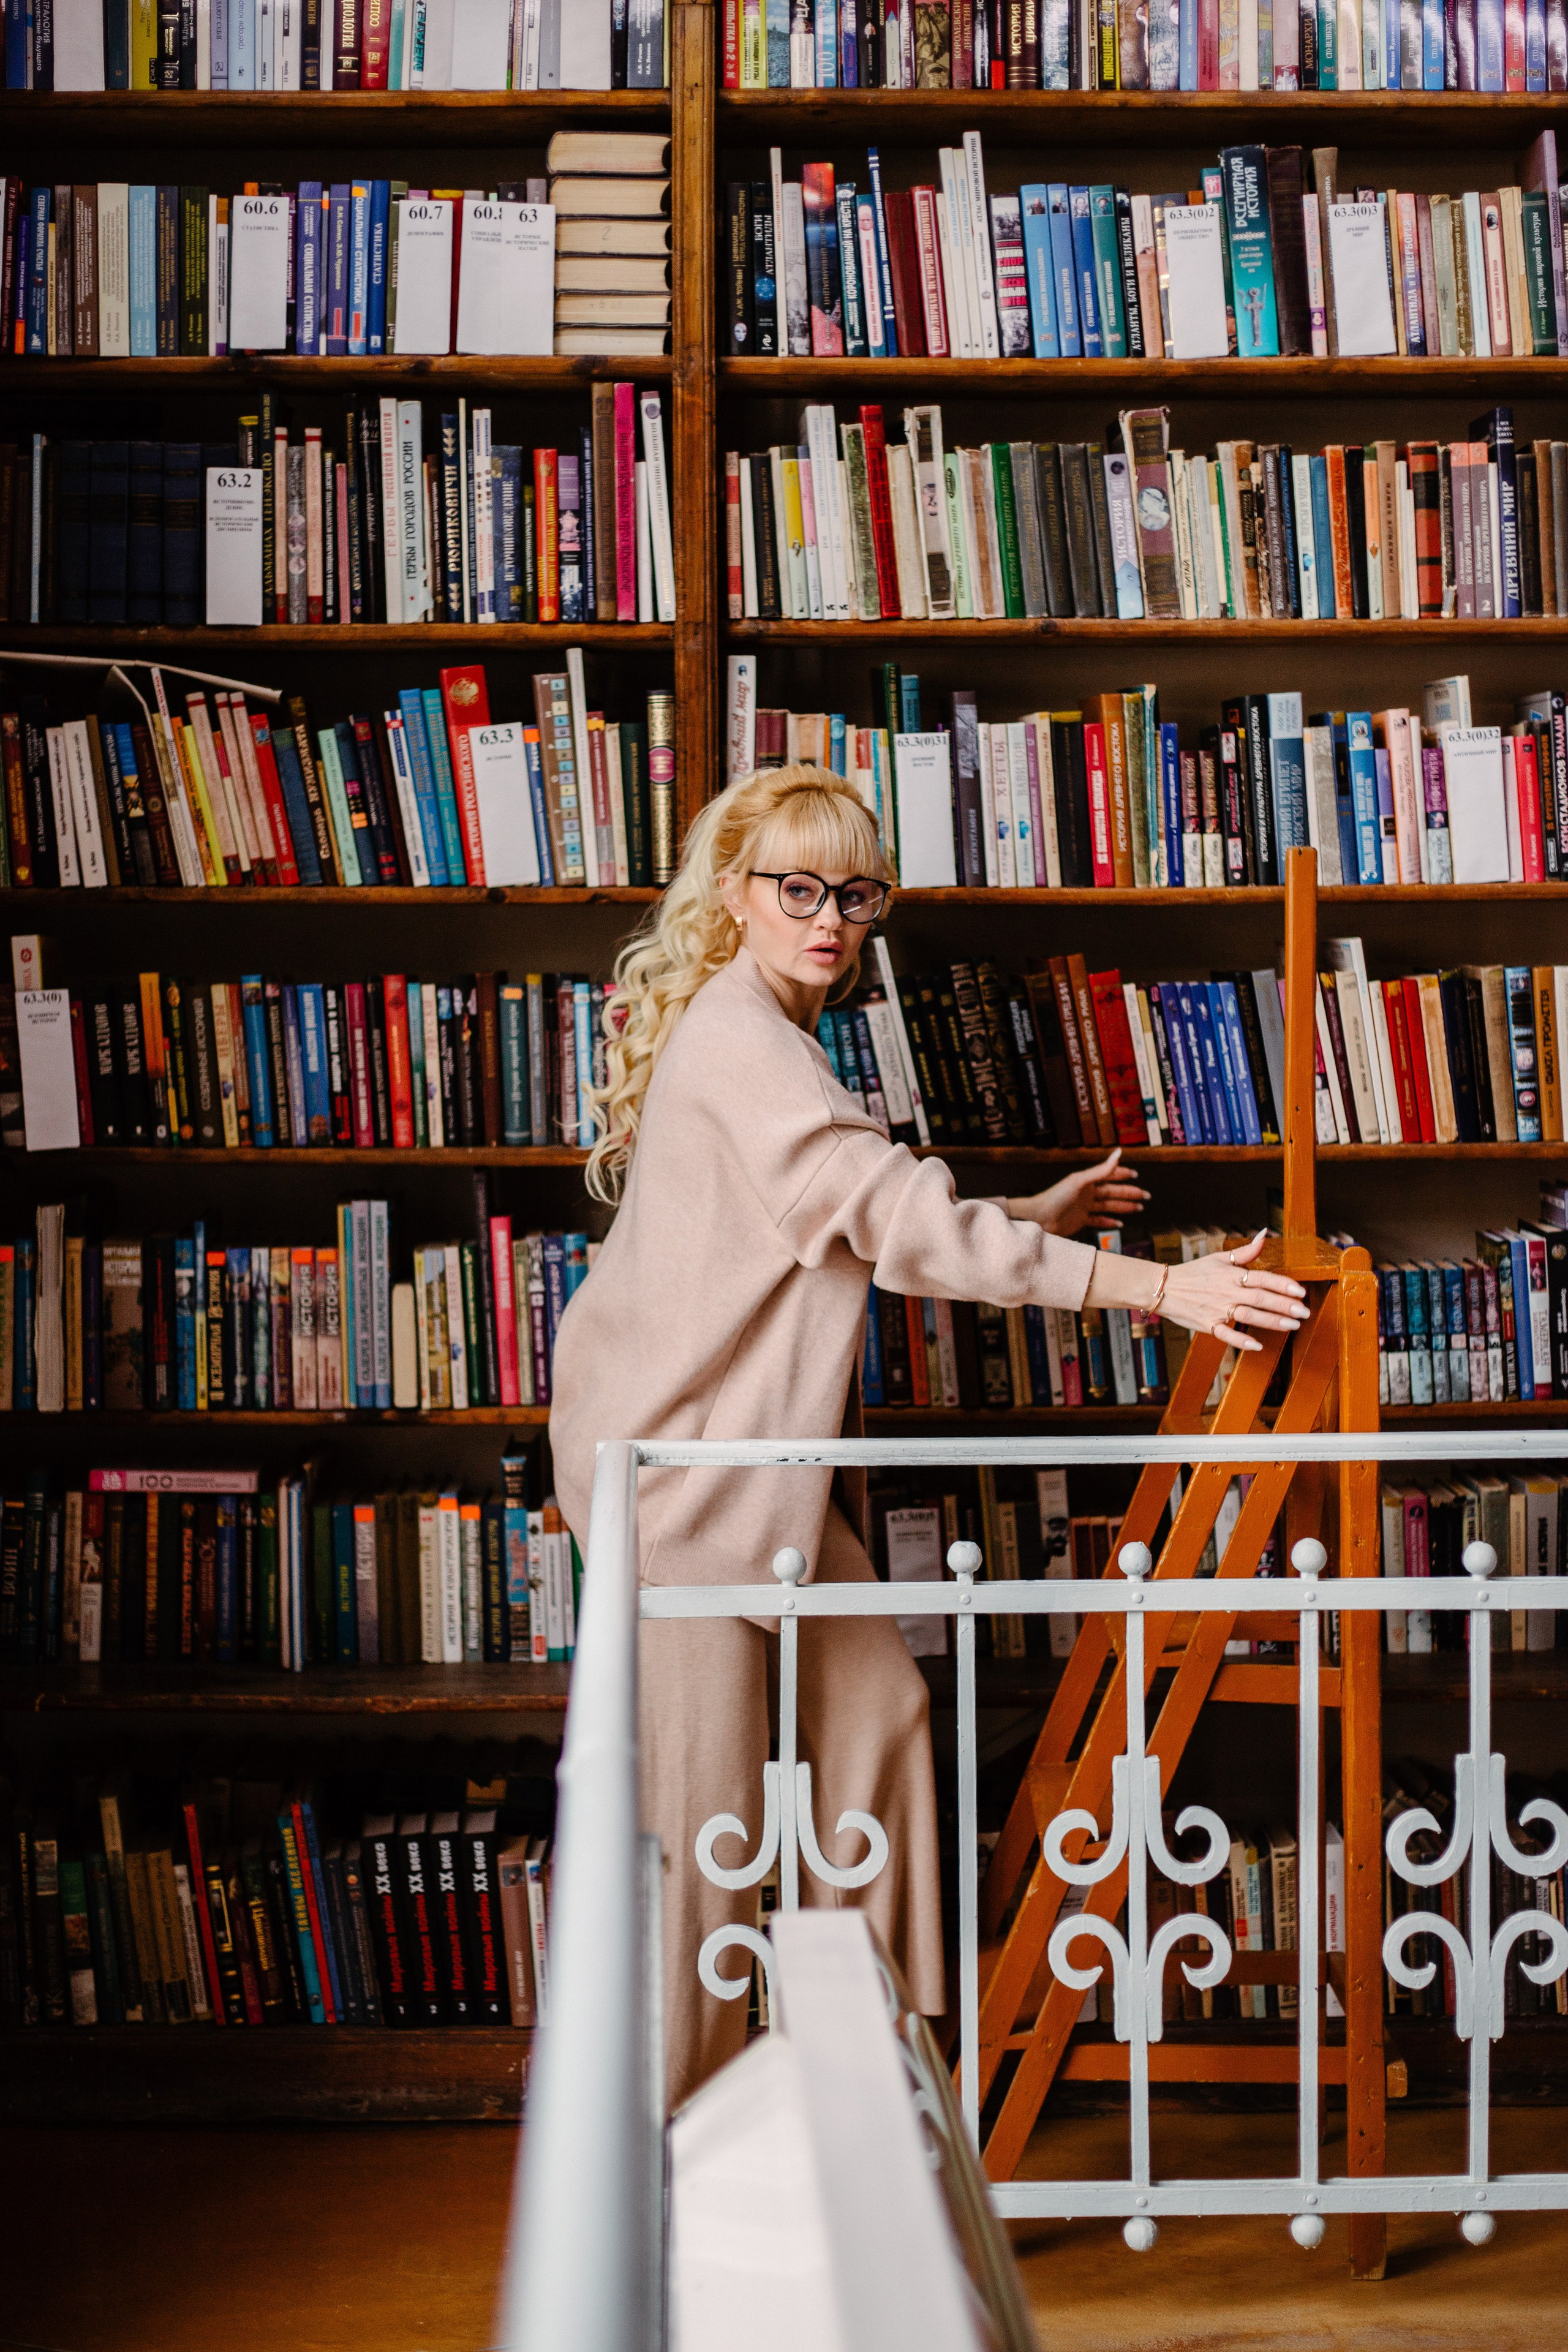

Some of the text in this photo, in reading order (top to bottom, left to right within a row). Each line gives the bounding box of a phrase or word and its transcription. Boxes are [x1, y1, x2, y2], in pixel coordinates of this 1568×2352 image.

[1011, 3, 1022, 56] ИСТОРИЯ
[1102, 24, 1115, 80] ПОКУШЕНИЕ
[244, 200, 279, 215] 60.6
[409, 205, 443, 221] 60.7
[518, 208, 538, 223] 63
[1169, 207, 1215, 221] 63.3(0)2
[1334, 204, 1378, 217] 63.3(0)3
[753, 214, 763, 241] БОГИ
[1121, 217, 1134, 267] ВЕЛИКАНЫ
[1532, 211, 1542, 244] культуры
[353, 197, 365, 304] ОЦИАЛЬНАЯ СТАТИСТИКА
[372, 222, 382, 285] СТАТИСТИКА
[764, 214, 774, 276] АТЛАНТИДЫ
[842, 200, 856, 300] КОРОНОВАННЫЙ НА КРЕСТЕ
[1536, 277, 1547, 307] История
[1407, 290, 1420, 343] АТЛАНТИДА
[217, 473, 252, 488] 63.2
[400, 441, 418, 580] ГЕРБЫ ГОРОДОВ РОССИИ
[1501, 480, 1520, 601] ДРЕВНИЙ МИР
[480, 729, 513, 745] 63.3
[897, 734, 948, 748] 63.3(0)31
[1448, 729, 1501, 744] 63.3(0)32
[356, 1521, 373, 1581] Истори
